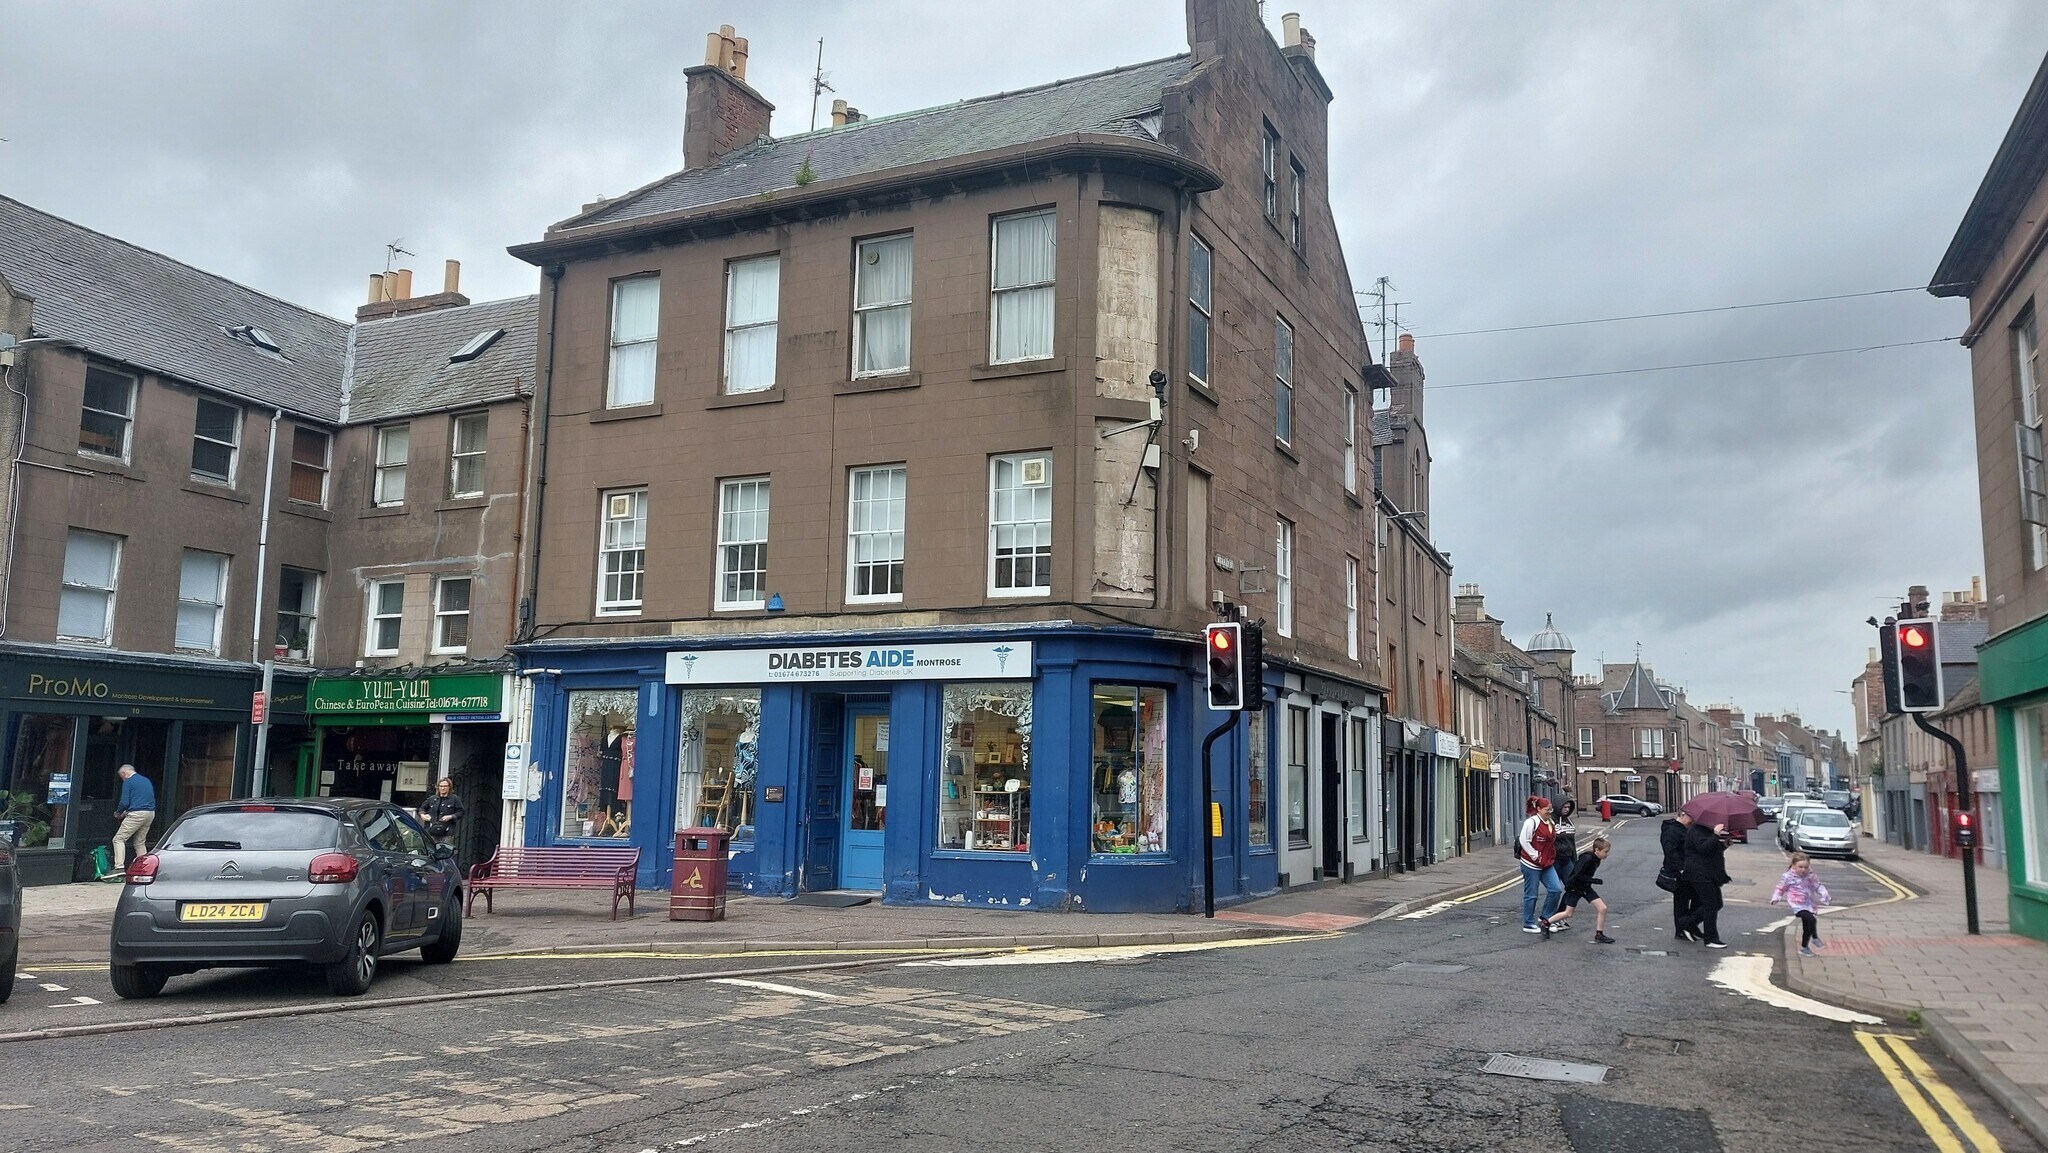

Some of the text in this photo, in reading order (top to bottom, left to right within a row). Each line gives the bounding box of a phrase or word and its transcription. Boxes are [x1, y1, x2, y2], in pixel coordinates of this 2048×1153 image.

[768, 649, 962, 670] DIABETES AIDE MONTROSE
[829, 668, 914, 678] Supporting Diabetes UK
[28, 673, 109, 699] ProMo
[111, 692, 138, 701] Montrose
[138, 694, 174, 704] Development
[180, 697, 215, 706] Improvement
[314, 698, 346, 711] Chinese
[346, 700, 354, 710] &
[132, 707, 140, 715] 10
[338, 759, 398, 775] Take away
[190, 904, 256, 918] LD24 ZCA
